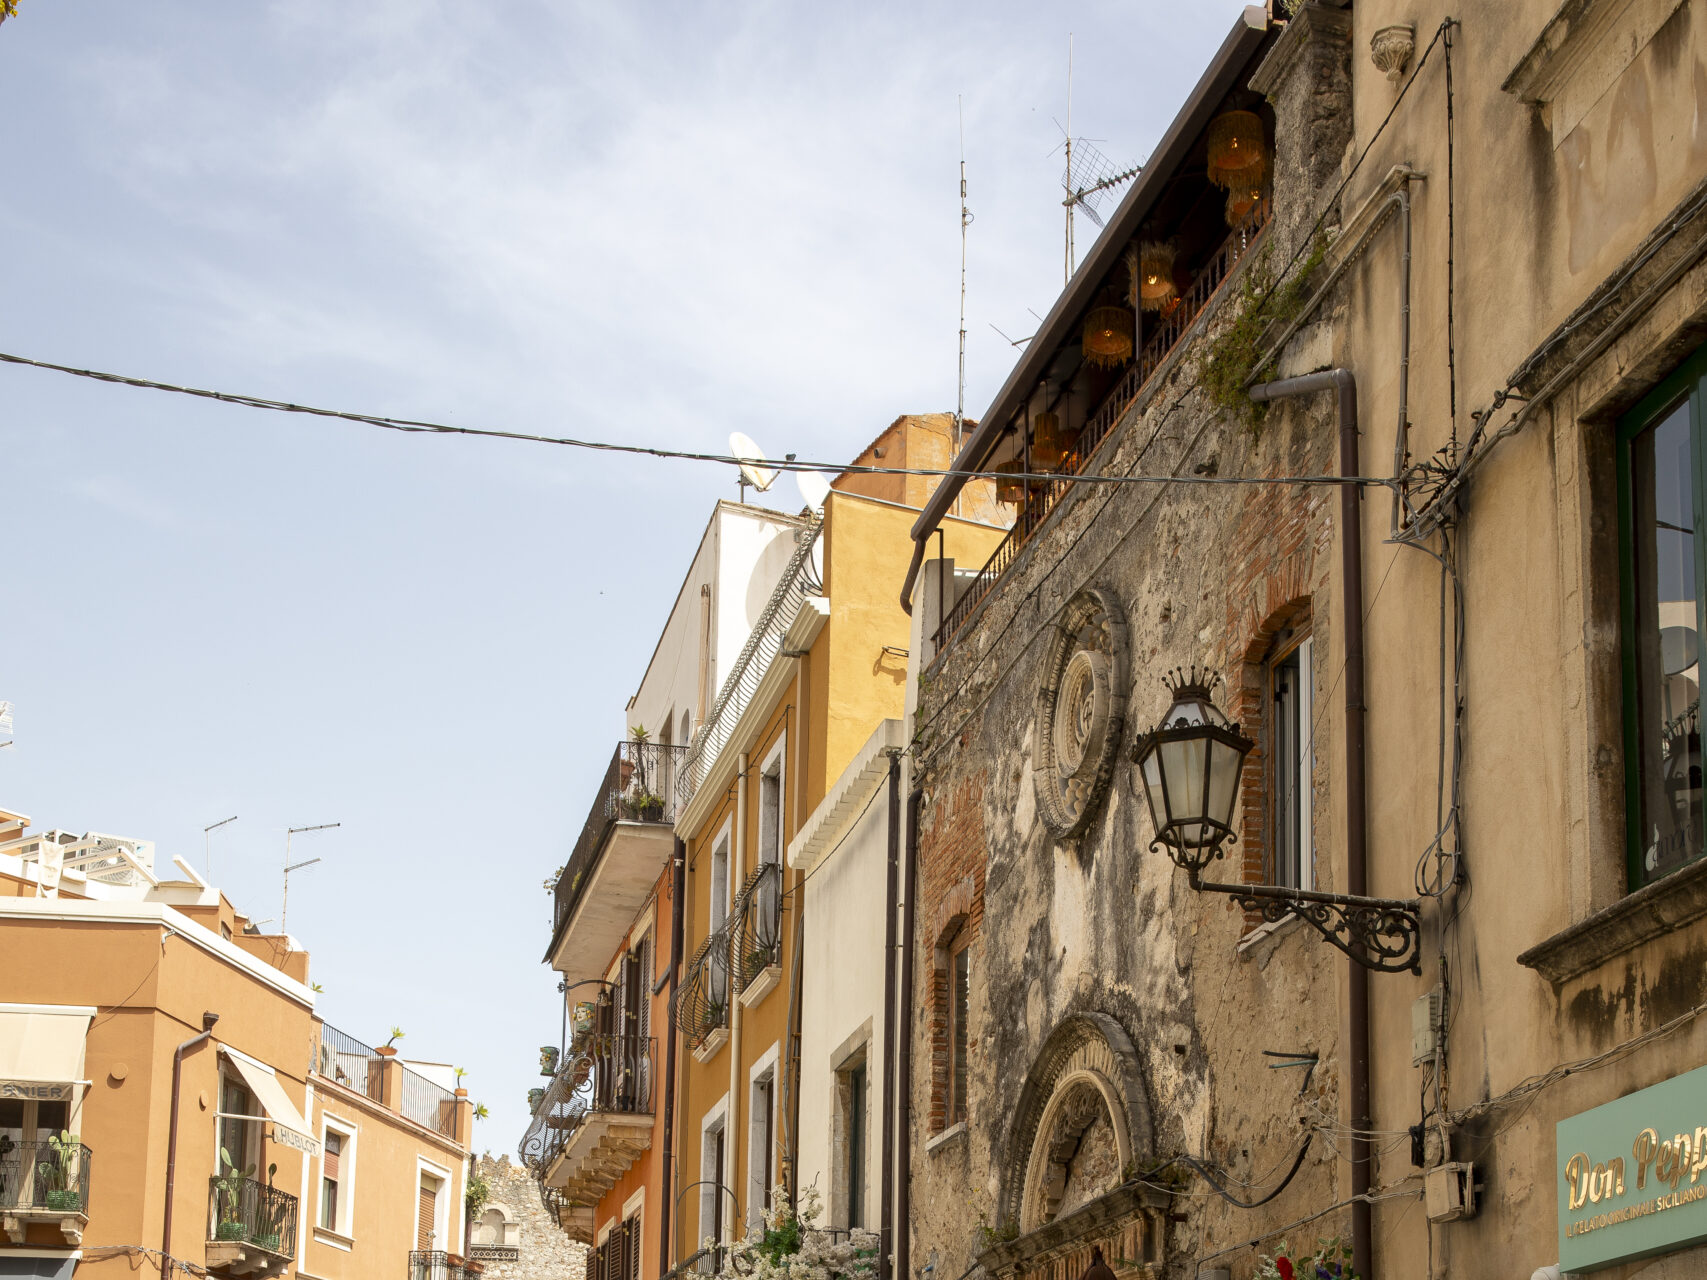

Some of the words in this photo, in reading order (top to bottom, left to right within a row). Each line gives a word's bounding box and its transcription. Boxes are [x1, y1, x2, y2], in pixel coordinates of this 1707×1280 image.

[280, 1128, 317, 1155] HUBLOT
[1564, 1151, 1627, 1212] Don
[1565, 1223, 1575, 1239] IL
[1574, 1213, 1608, 1235] GELATO
[1607, 1200, 1657, 1226] ORIGINALE
[1656, 1184, 1706, 1211] SICILIANO
